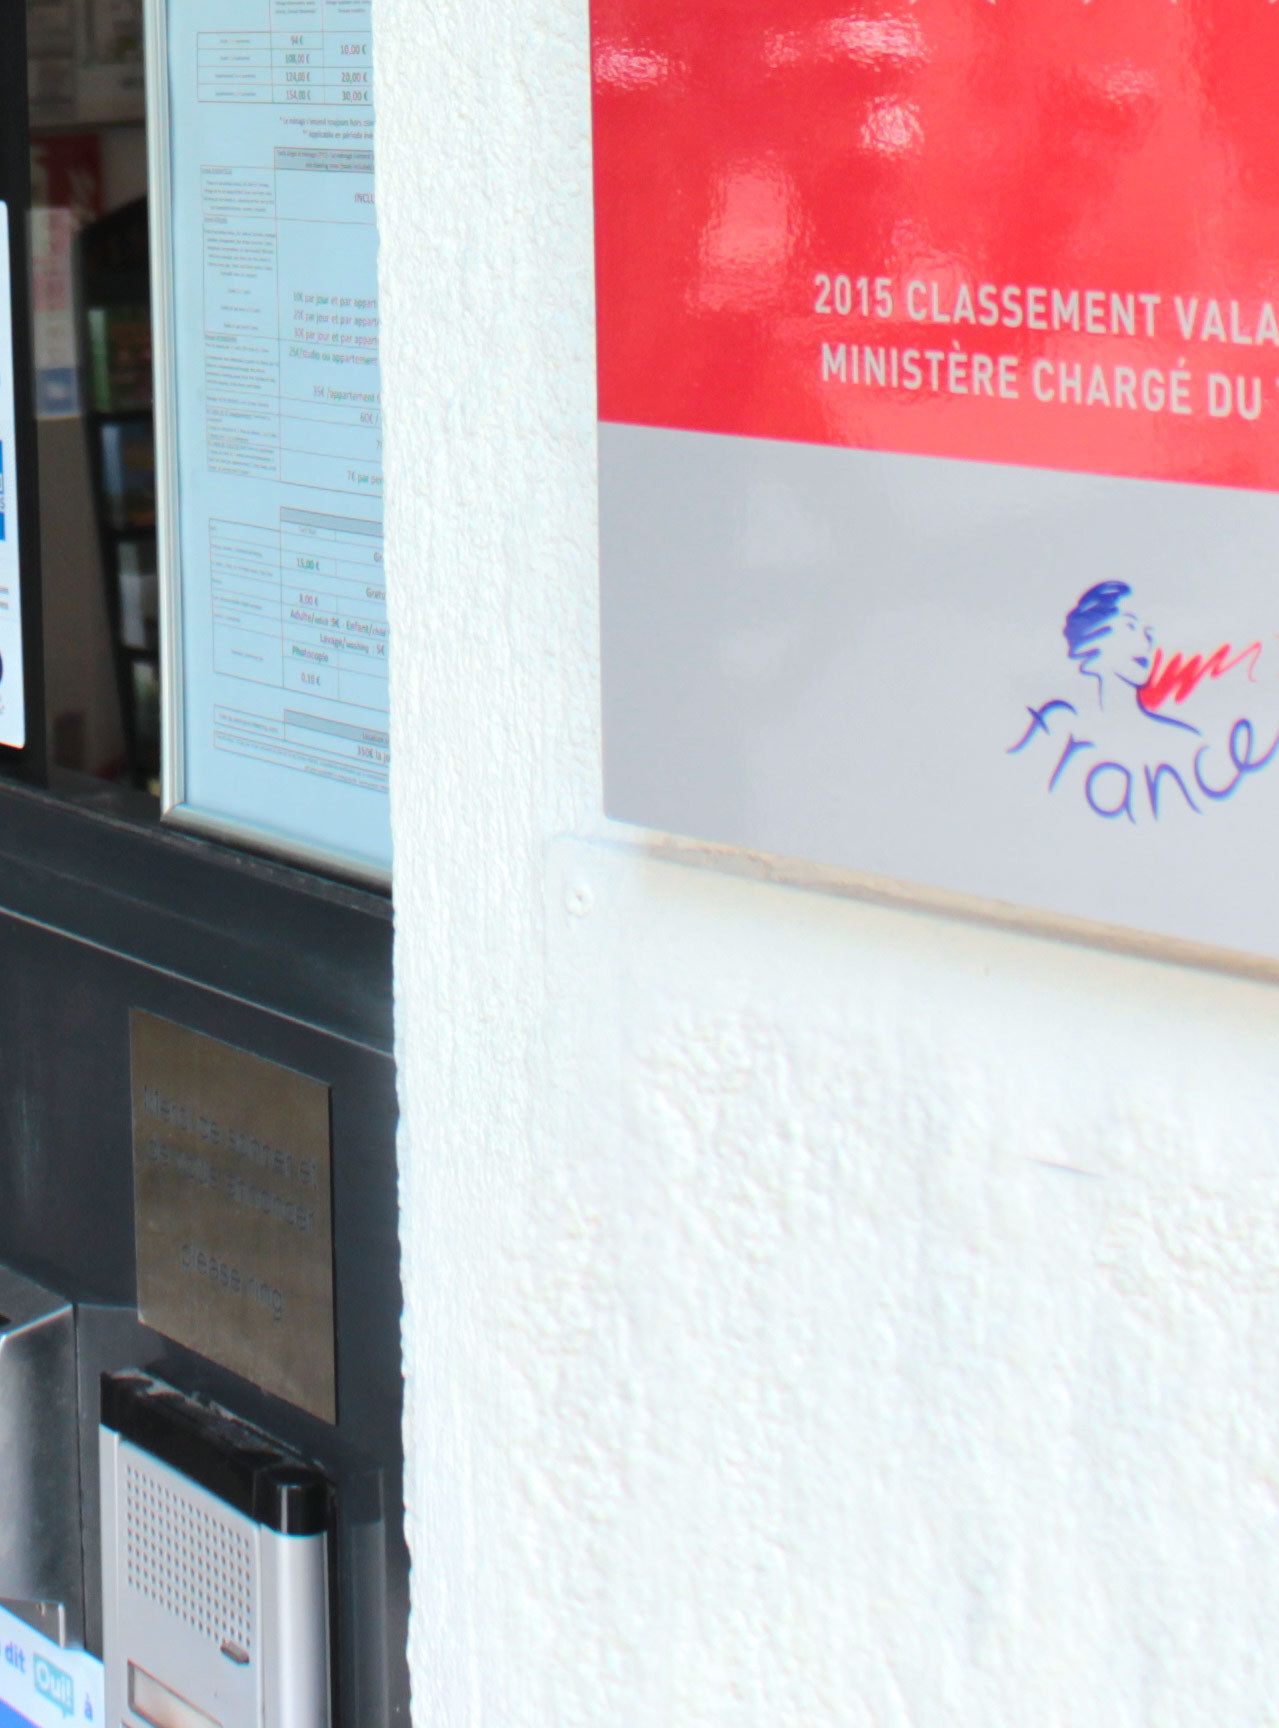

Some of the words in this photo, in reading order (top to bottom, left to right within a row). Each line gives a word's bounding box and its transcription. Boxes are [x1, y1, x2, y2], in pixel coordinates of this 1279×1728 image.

[812, 273, 894, 319] 2015
[906, 278, 1161, 338] CLASSEMENT
[819, 341, 1019, 400] MINISTÈRE
[1031, 355, 1192, 415] CHARGÉ
[1208, 373, 1263, 422] DU
[4, 1633, 26, 1674] dit
[83, 1692, 94, 1721] à
